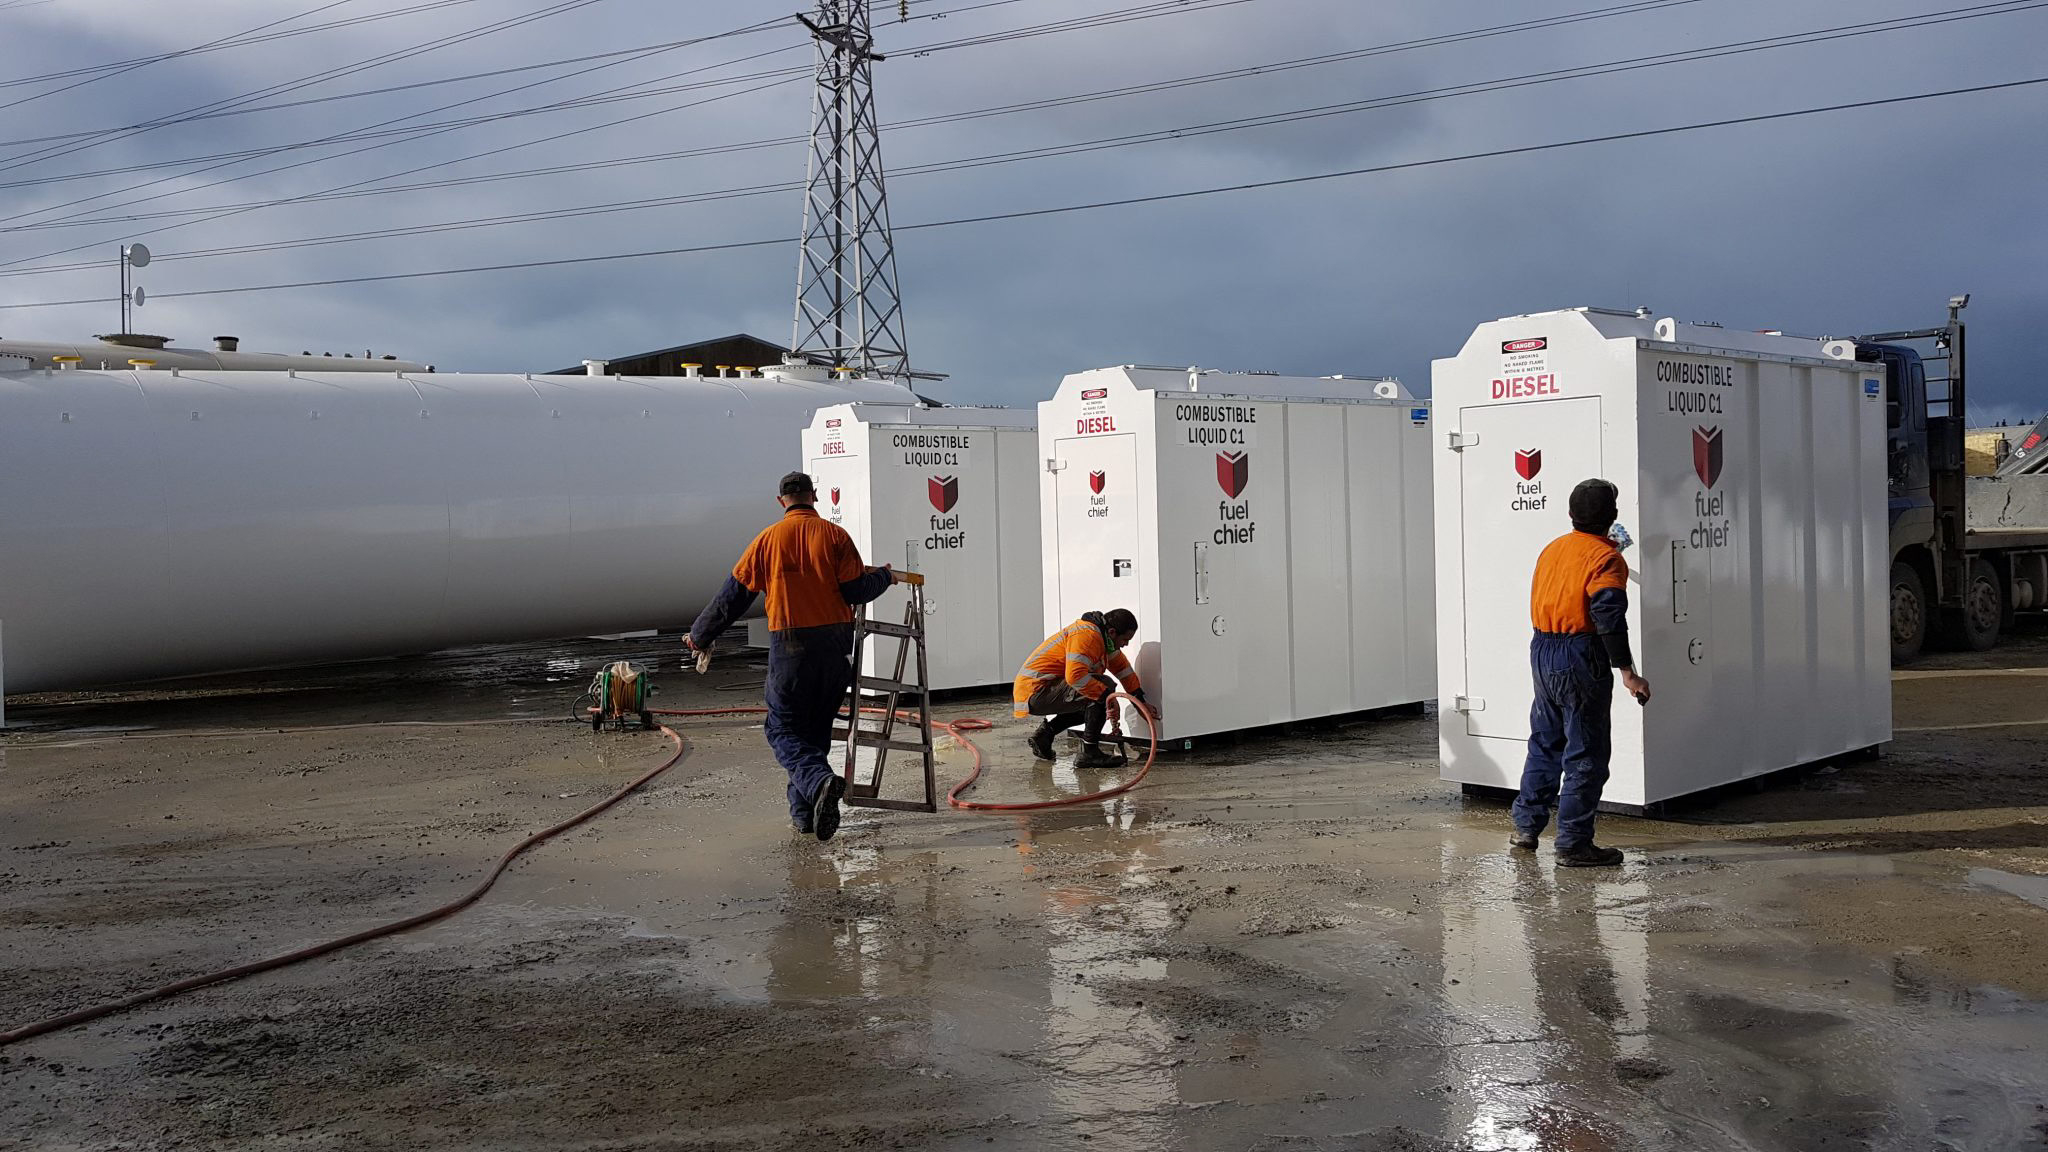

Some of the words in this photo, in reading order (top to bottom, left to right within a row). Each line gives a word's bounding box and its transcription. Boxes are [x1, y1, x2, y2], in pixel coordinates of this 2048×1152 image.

[1512, 342, 1536, 350] DANGER
[1656, 360, 1733, 387] COMBUSTIBLE
[1492, 373, 1560, 400] DIESEL
[1668, 391, 1706, 416] LIQUID
[1708, 394, 1723, 415] C1
[1176, 404, 1256, 424] COMBUSTIBLE
[1076, 416, 1116, 435] DIESEL
[893, 434, 970, 449] COMBUSTIBLE
[1188, 427, 1227, 447] LIQUID
[1230, 428, 1245, 444] C1
[822, 441, 846, 455] DIESEL
[904, 451, 942, 467] LIQUID
[944, 452, 959, 465] C1
[1516, 481, 1542, 495] fuel
[1090, 495, 1106, 506] fuel
[1511, 495, 1547, 511] chief
[1694, 491, 1724, 517] fuel
[829, 515, 843, 524] chief
[831, 506, 841, 515] fuel
[1088, 506, 1109, 518] chief
[1219, 500, 1249, 521] fuel
[930, 514, 959, 531] fuel
[924, 531, 965, 550] chief
[1213, 522, 1256, 545] chief
[1690, 521, 1730, 549] chief
